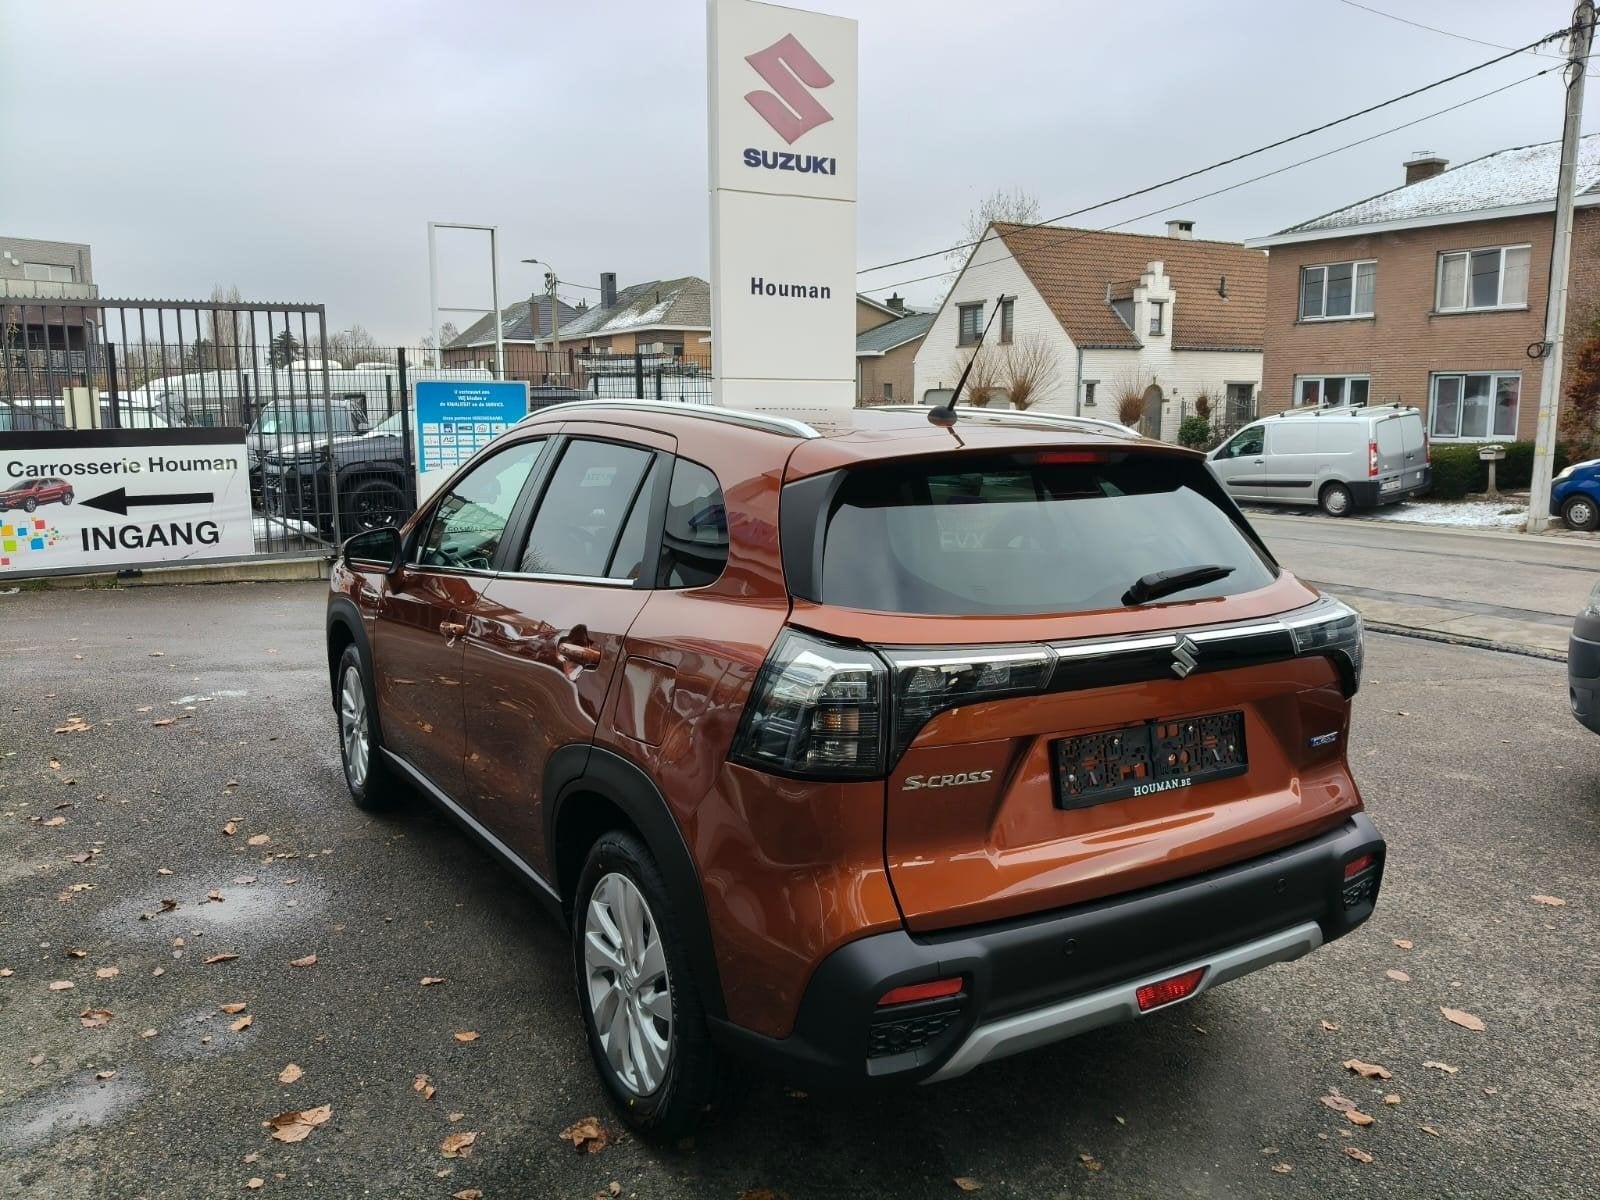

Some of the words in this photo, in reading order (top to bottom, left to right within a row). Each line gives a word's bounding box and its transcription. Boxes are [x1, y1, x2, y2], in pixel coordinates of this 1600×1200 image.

[743, 148, 836, 175] SUZUKI
[750, 277, 831, 299] Houman
[6, 457, 141, 478] Carrosserie
[149, 456, 238, 473] Houman
[81, 520, 220, 552] INGANG
[902, 770, 993, 791] S-CROSS
[1133, 778, 1192, 797] HOUMAN.BE
